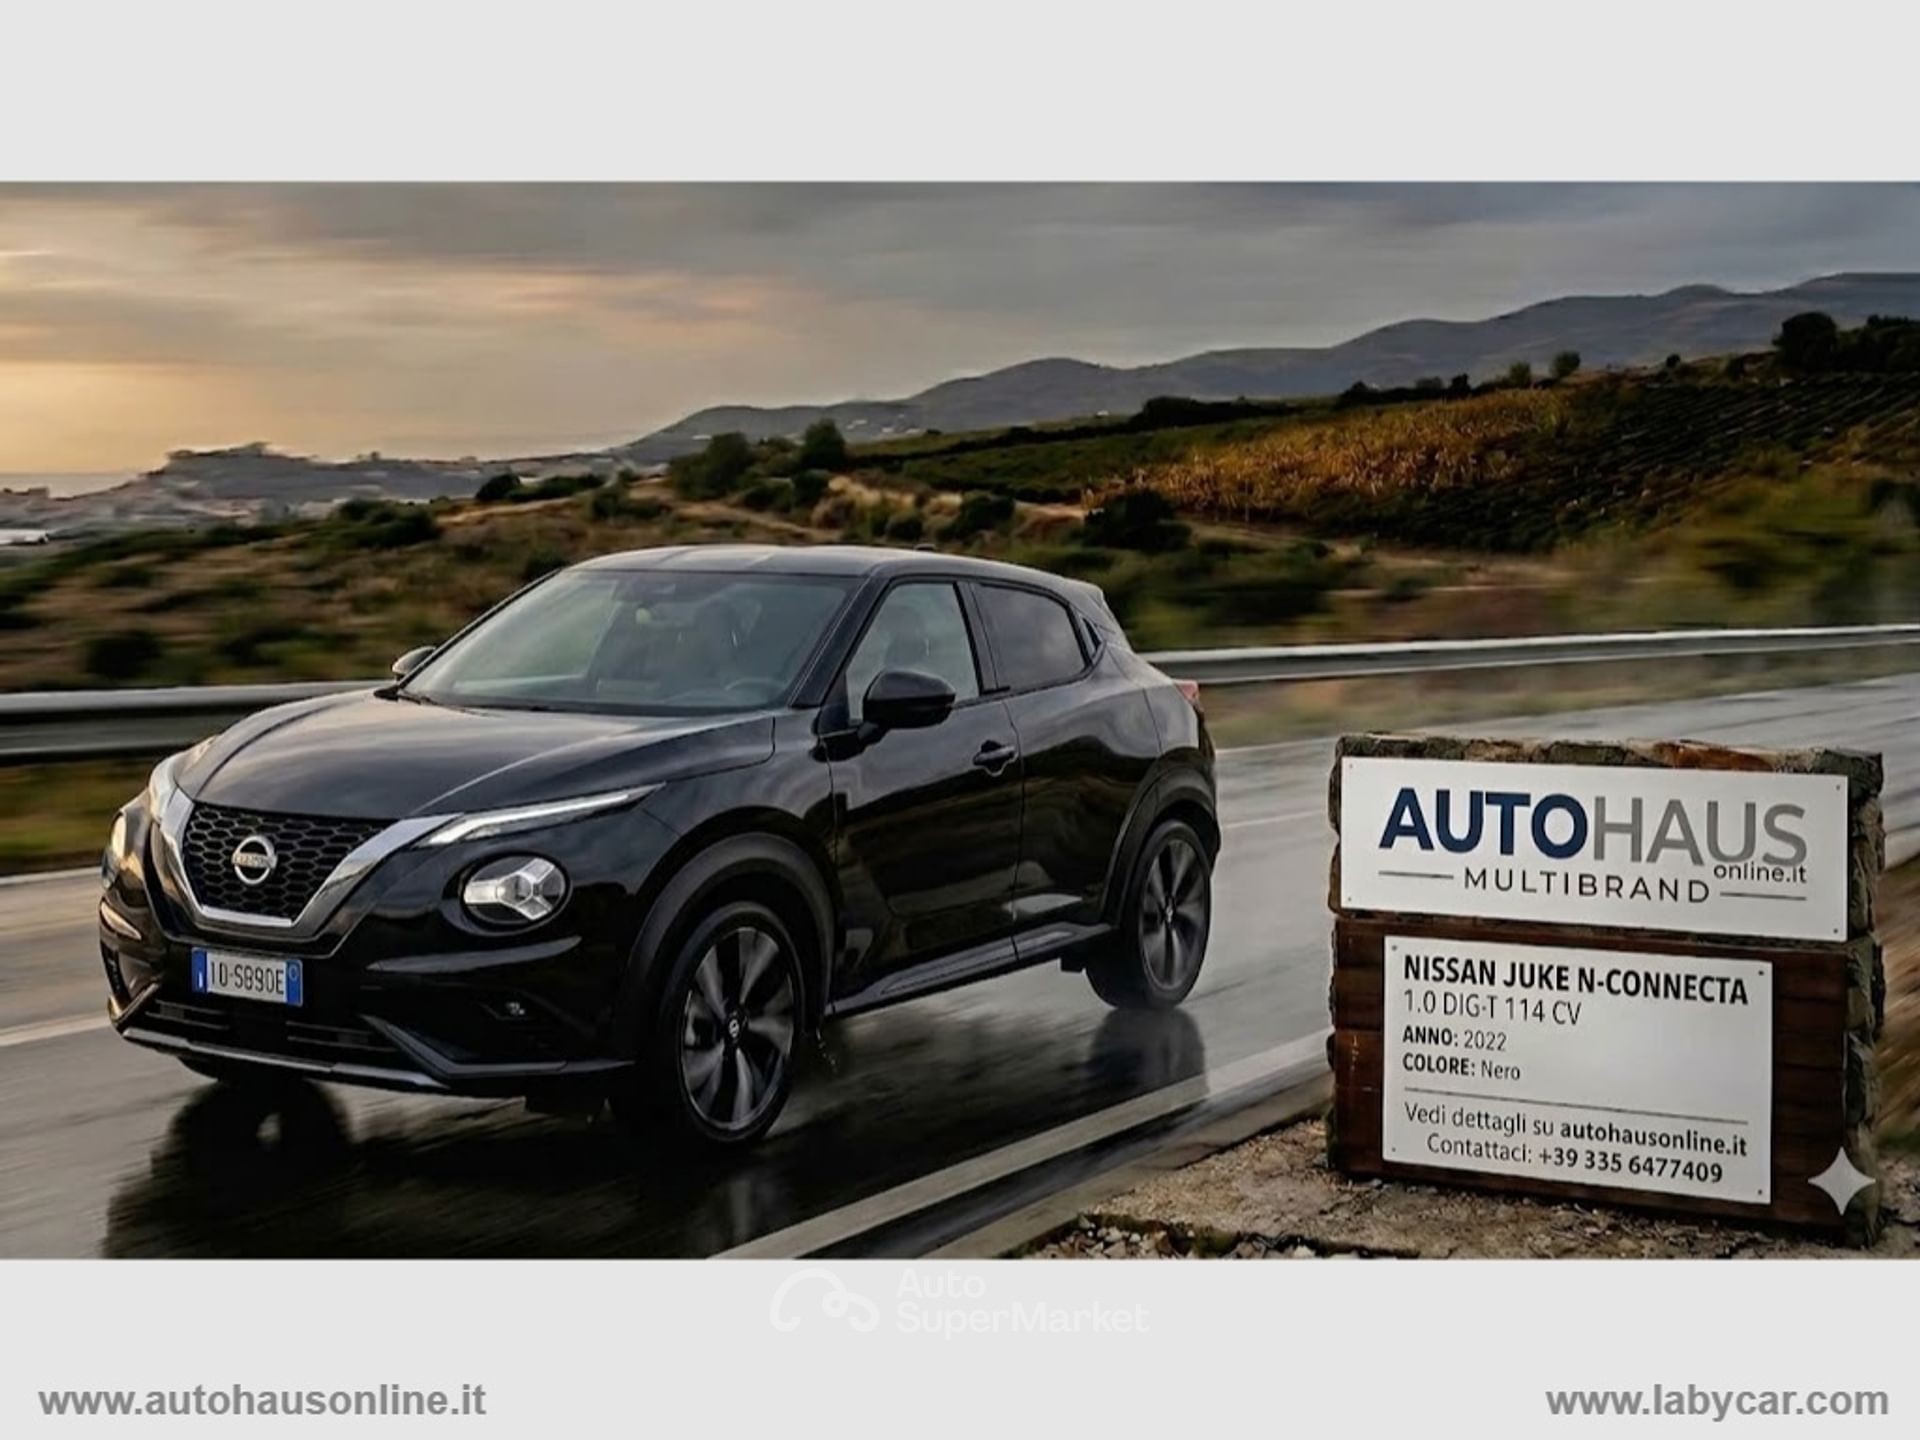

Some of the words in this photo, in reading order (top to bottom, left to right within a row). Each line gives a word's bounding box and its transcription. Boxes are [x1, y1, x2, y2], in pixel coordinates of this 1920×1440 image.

[1379, 787, 1807, 867] AUTOHAUS
[1464, 866, 1709, 902] MULTIBRAND
[1713, 861, 1807, 884] online.it
[1404, 954, 1496, 986] NISSAN
[1503, 961, 1569, 992] JUKE
[1578, 967, 1749, 1006] N-CONNECTA
[1404, 988, 1436, 1014] 1.0
[1505, 997, 1545, 1023] 114
[1552, 1000, 1582, 1026] CV
[1402, 1025, 1459, 1048] ANNO:
[1464, 1029, 1507, 1052] 2022
[1402, 1052, 1476, 1077] COLORE:
[1481, 1059, 1521, 1081] Nero
[1405, 1102, 1446, 1126] Vedi
[1451, 1107, 1527, 1137] dettagli
[1533, 1120, 1555, 1137] su
[1560, 1120, 1748, 1157] autohausonline.it
[1427, 1132, 1533, 1164] Contattaci:
[1538, 1147, 1578, 1167] +39
[1584, 1151, 1622, 1173] 335
[1628, 1156, 1723, 1183] 6477409
